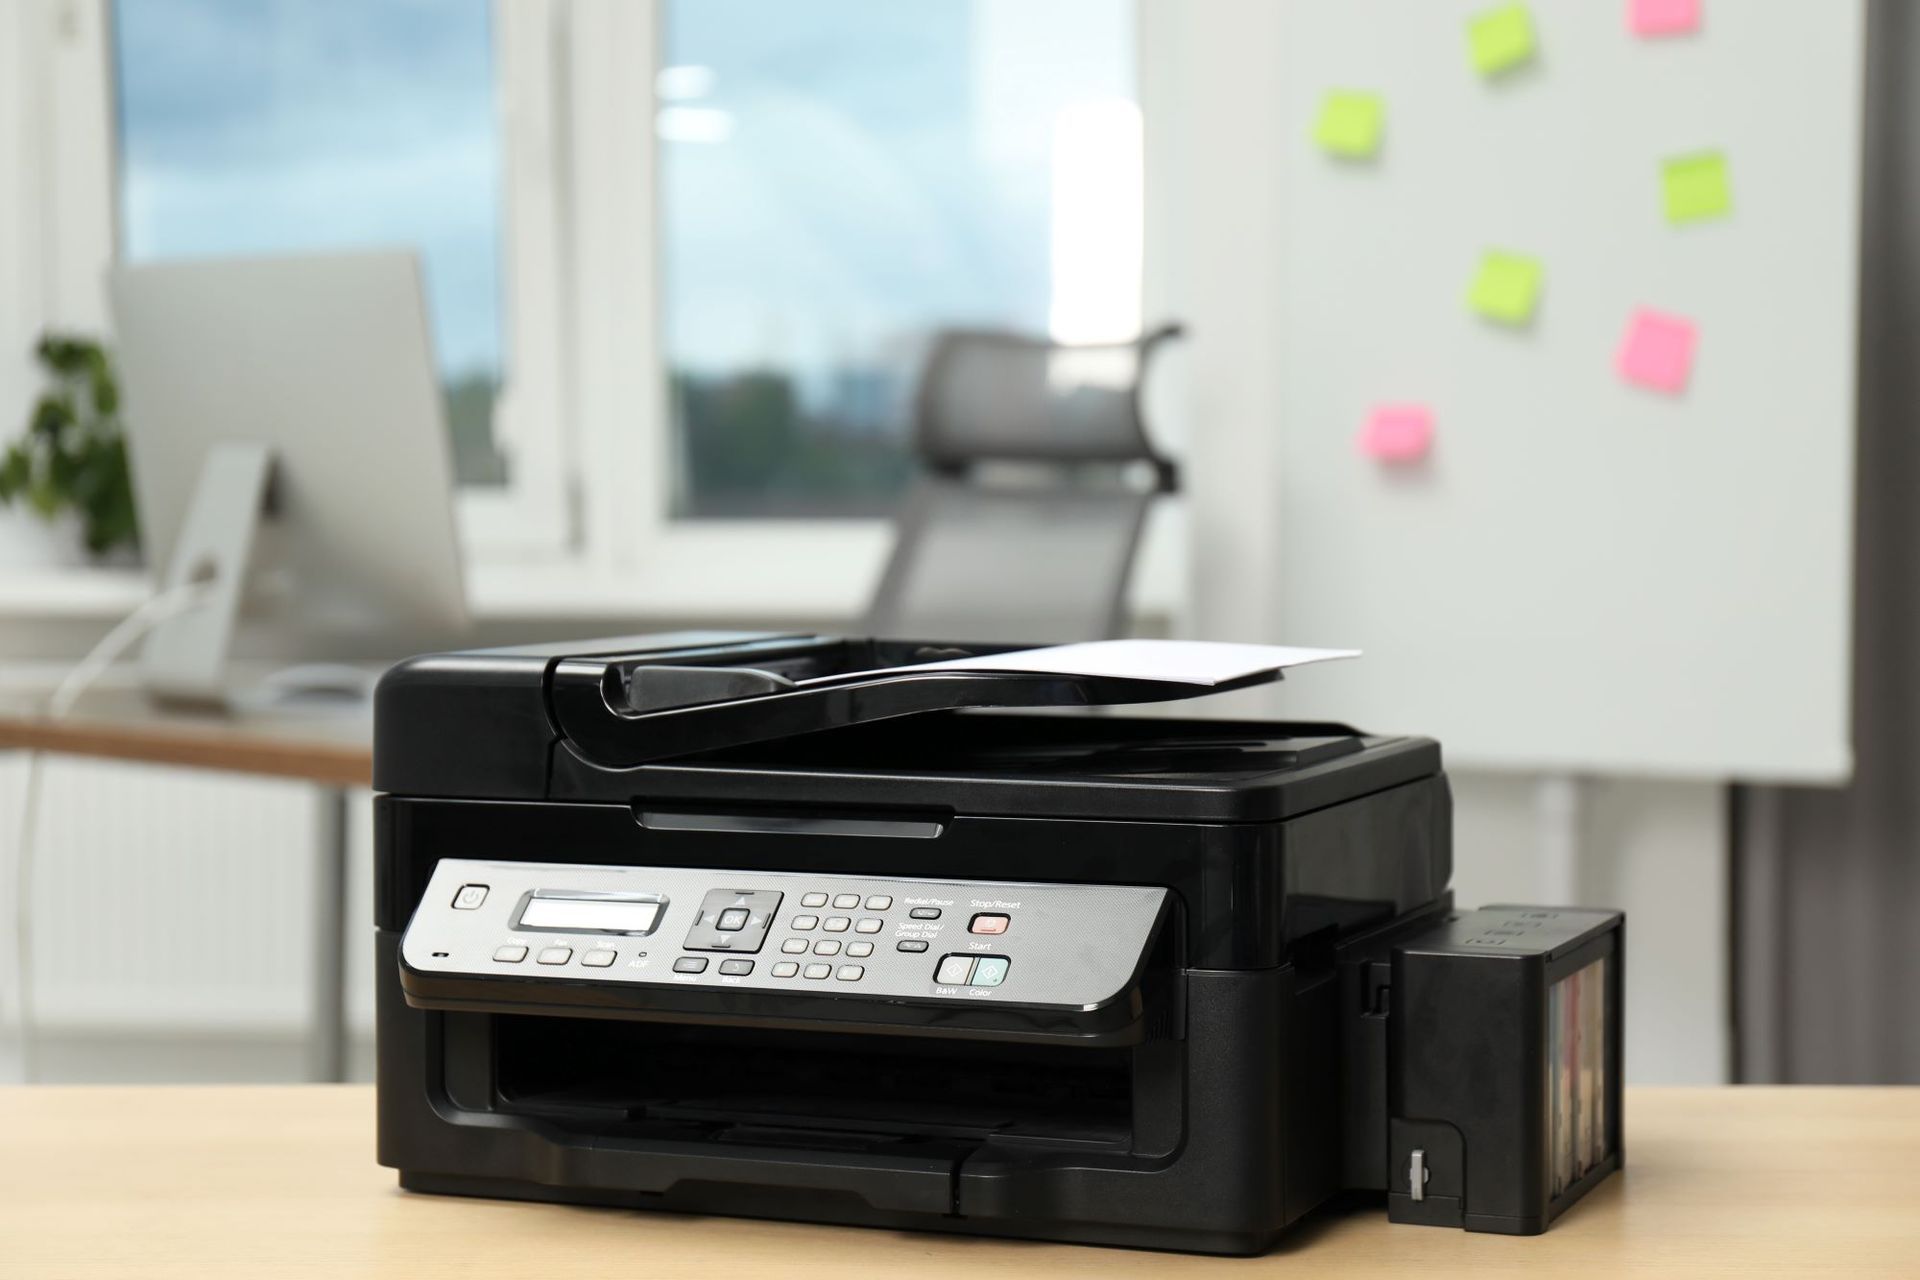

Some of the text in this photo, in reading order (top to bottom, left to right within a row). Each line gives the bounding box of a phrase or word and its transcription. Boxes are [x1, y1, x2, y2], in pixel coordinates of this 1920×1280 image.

[904, 897, 954, 906] Redial/Pause
[970, 900, 1021, 909] Stop/Reset
[724, 915, 743, 924] OK
[898, 922, 923, 931] Speed
[895, 930, 920, 938] Group
[968, 942, 992, 950] Start
[935, 987, 992, 996] B&W Color
